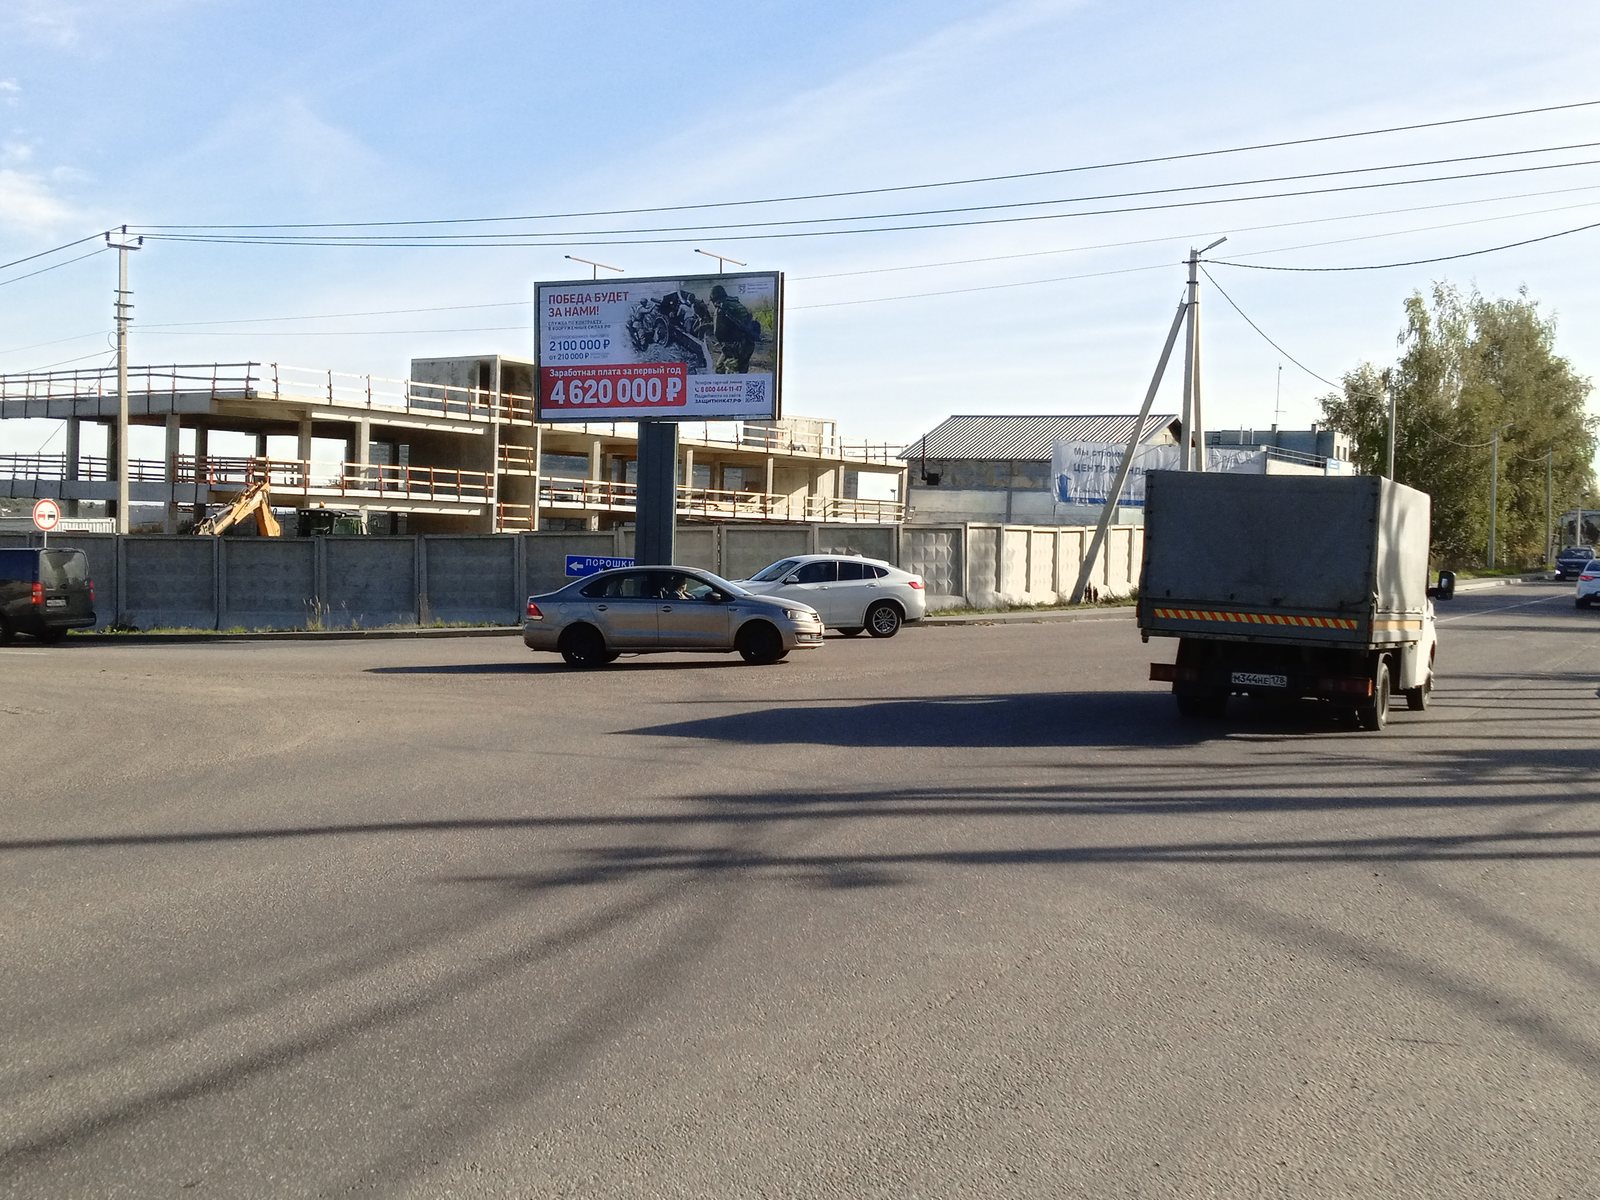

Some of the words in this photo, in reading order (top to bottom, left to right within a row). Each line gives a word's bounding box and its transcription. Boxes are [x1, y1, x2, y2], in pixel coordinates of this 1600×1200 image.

[548, 293, 592, 305] ПОБЕДА
[594, 291, 629, 303] БУДЕТ
[548, 307, 562, 317] ЗА
[564, 306, 599, 317] НАМИ!
[549, 368, 596, 378] Заработная
[597, 368, 621, 376] плата
[633, 366, 665, 376] первый
[666, 367, 682, 375] год
[1074, 447, 1089, 456] Мы
[1073, 463, 1106, 473] ЦЕНТР
[1108, 465, 1149, 476] АРНДЫ
